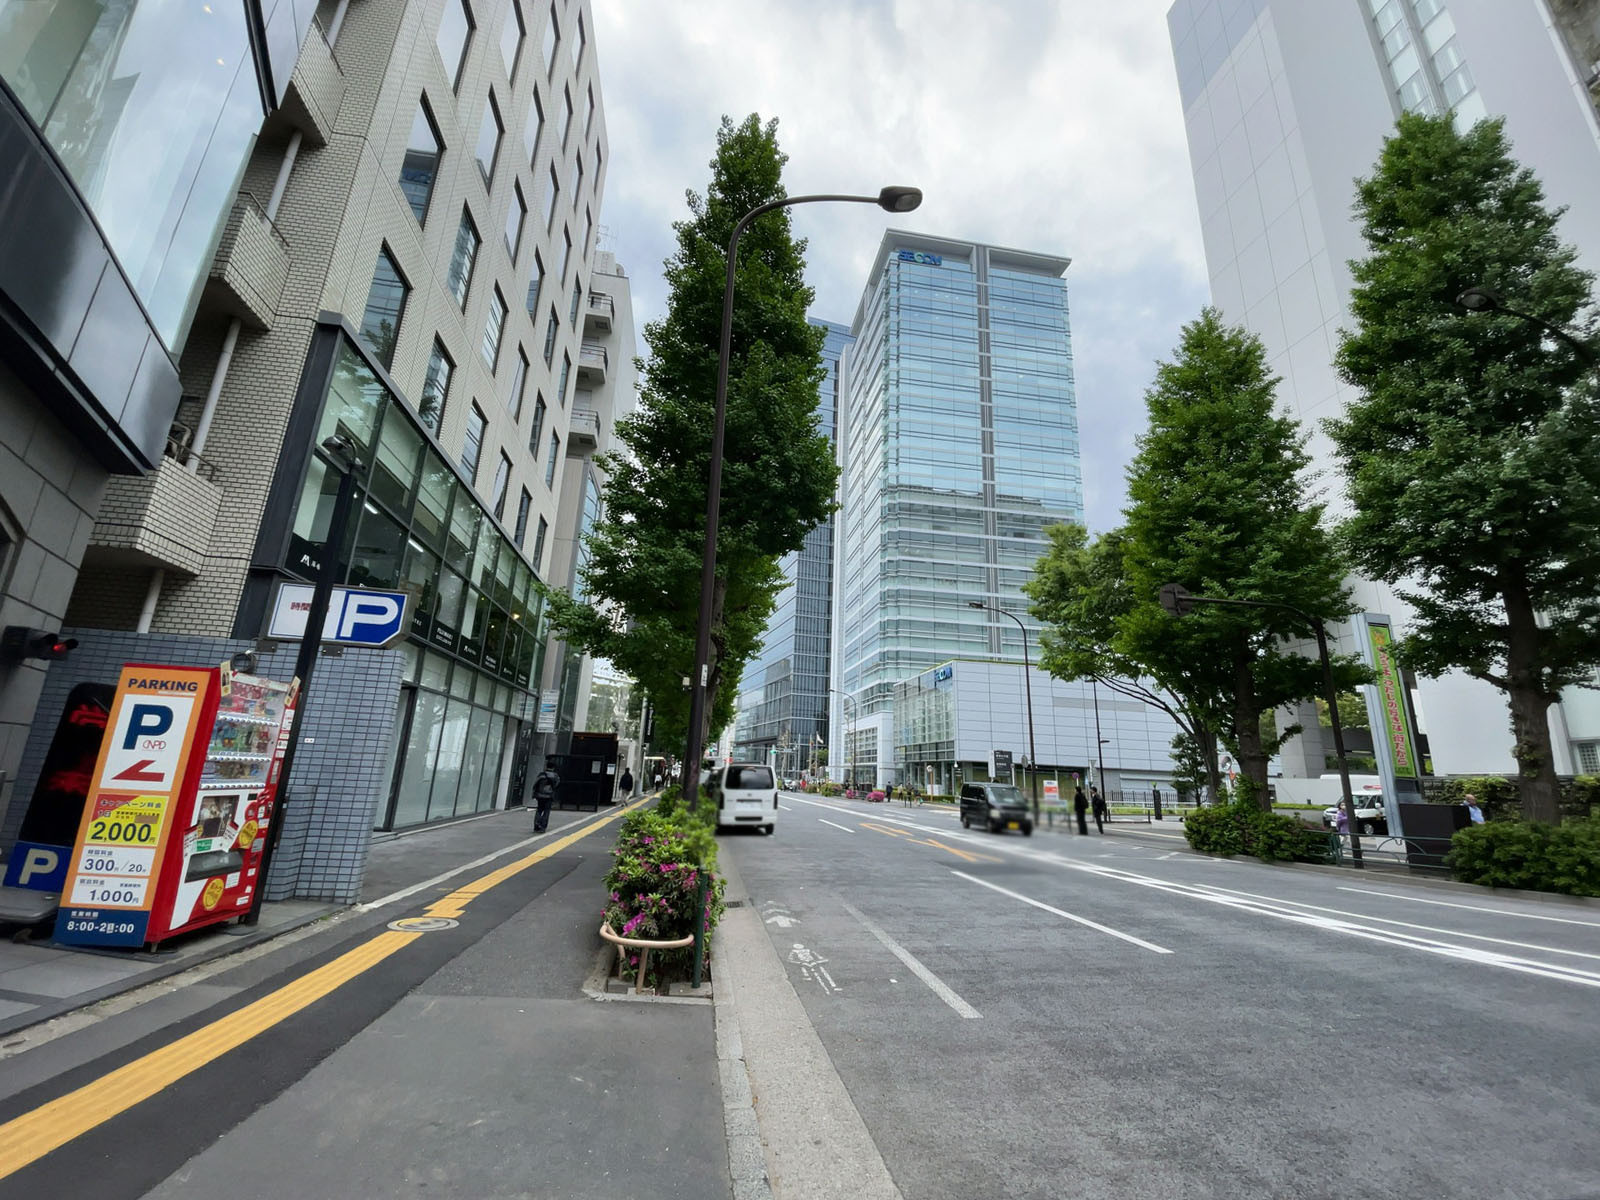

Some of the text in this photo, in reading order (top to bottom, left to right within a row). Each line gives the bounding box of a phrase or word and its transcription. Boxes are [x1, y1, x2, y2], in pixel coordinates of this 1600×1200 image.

[898, 249, 943, 266] SECOM
[340, 594, 399, 638] P
[128, 678, 198, 692] PARKING
[122, 703, 174, 751] P
[18, 848, 59, 885] P
[67, 920, 135, 934] 8:00-2:00
